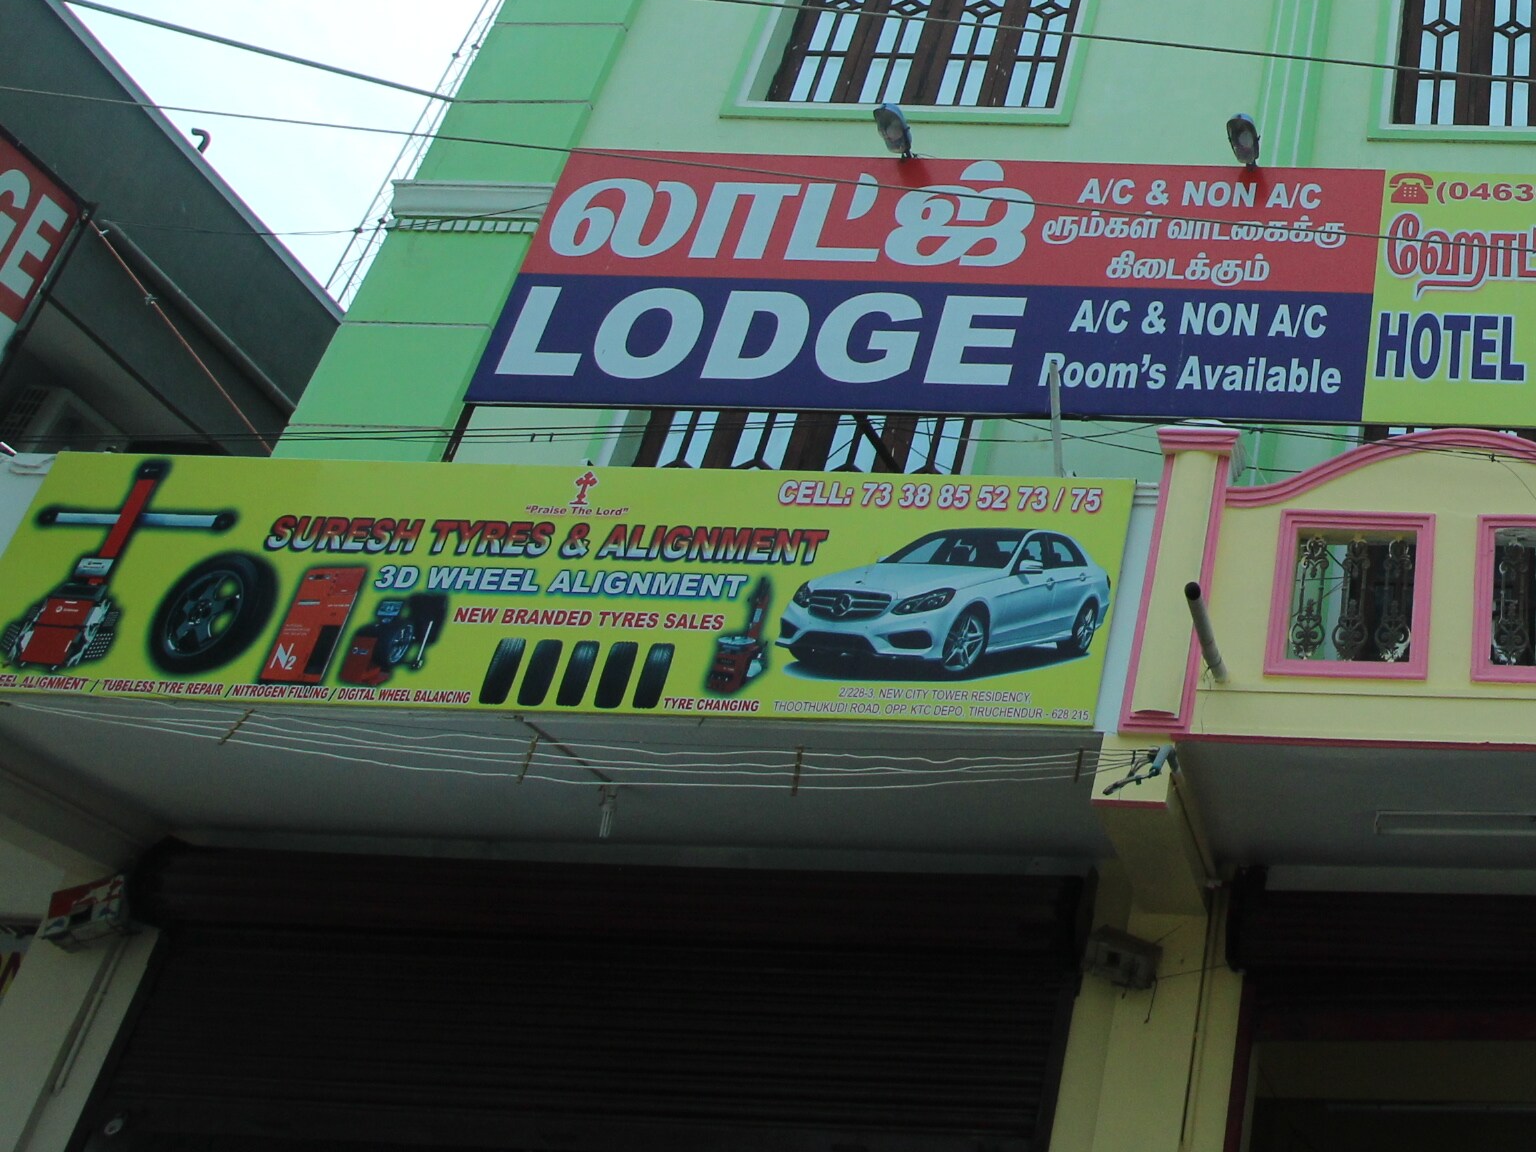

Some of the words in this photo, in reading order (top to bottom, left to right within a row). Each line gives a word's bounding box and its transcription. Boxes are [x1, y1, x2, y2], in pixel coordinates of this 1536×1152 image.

[1077, 178, 1135, 205] A/C
[1146, 179, 1169, 206] &
[1182, 181, 1256, 208] NON
[1266, 182, 1322, 209] A/C
[549, 160, 1036, 267] லாட்ஜ்
[1042, 211, 1162, 244] ரூம்கள்
[1167, 215, 1346, 248] வாடகைக்கு
[1105, 250, 1270, 287] கிடைக்கும்
[1069, 299, 1131, 334] A/C
[1142, 301, 1166, 335] &
[1179, 302, 1259, 337] NON
[1268, 304, 1328, 338] A/C
[494, 286, 1028, 385] LODGE
[1375, 312, 1525, 381] HOTEL
[1176, 356, 1341, 394] Available
[571, 506, 592, 515] The
[779, 481, 854, 505] CELL:
[861, 483, 894, 507] 73
[899, 484, 931, 508] 38
[937, 485, 971, 509] 85
[976, 486, 1011, 510] 52
[1017, 487, 1050, 511] 73
[1071, 488, 1102, 512] 75
[264, 515, 425, 554] SURESH
[430, 519, 555, 558] TYRES
[560, 521, 592, 559] &
[596, 524, 829, 564] ALIGNMENT
[375, 565, 420, 589] 3D
[426, 566, 539, 592] WHEEL
[547, 569, 748, 597] ALIGNMENT
[453, 607, 499, 625] NEW
[501, 608, 592, 627] BRANDED
[598, 610, 659, 629] TYRES
[664, 612, 725, 630] SALES
[19, 675, 88, 690] ALIGNMENT
[102, 680, 153, 693] TUBELESS
[157, 682, 184, 694] TYRE
[187, 683, 224, 696] REPAIR
[232, 685, 287, 699] NITROGEN
[288, 687, 330, 699] FILLING
[337, 689, 375, 701] DIGITAL
[378, 690, 411, 702] WHEEL
[413, 691, 471, 703] BALANCING
[664, 698, 694, 710] TYRE
[696, 699, 760, 712] CHANGING
[879, 689, 903, 699] NEW
[905, 689, 929, 699] CITY
[931, 689, 968, 701] TOWER
[970, 690, 1031, 704] RESIDENCY,
[773, 700, 848, 713] THOOTHUKUDI
[911, 704, 932, 715] KTC
[969, 706, 1043, 719] TIRUCHENDUR
[1051, 709, 1070, 719] 628
